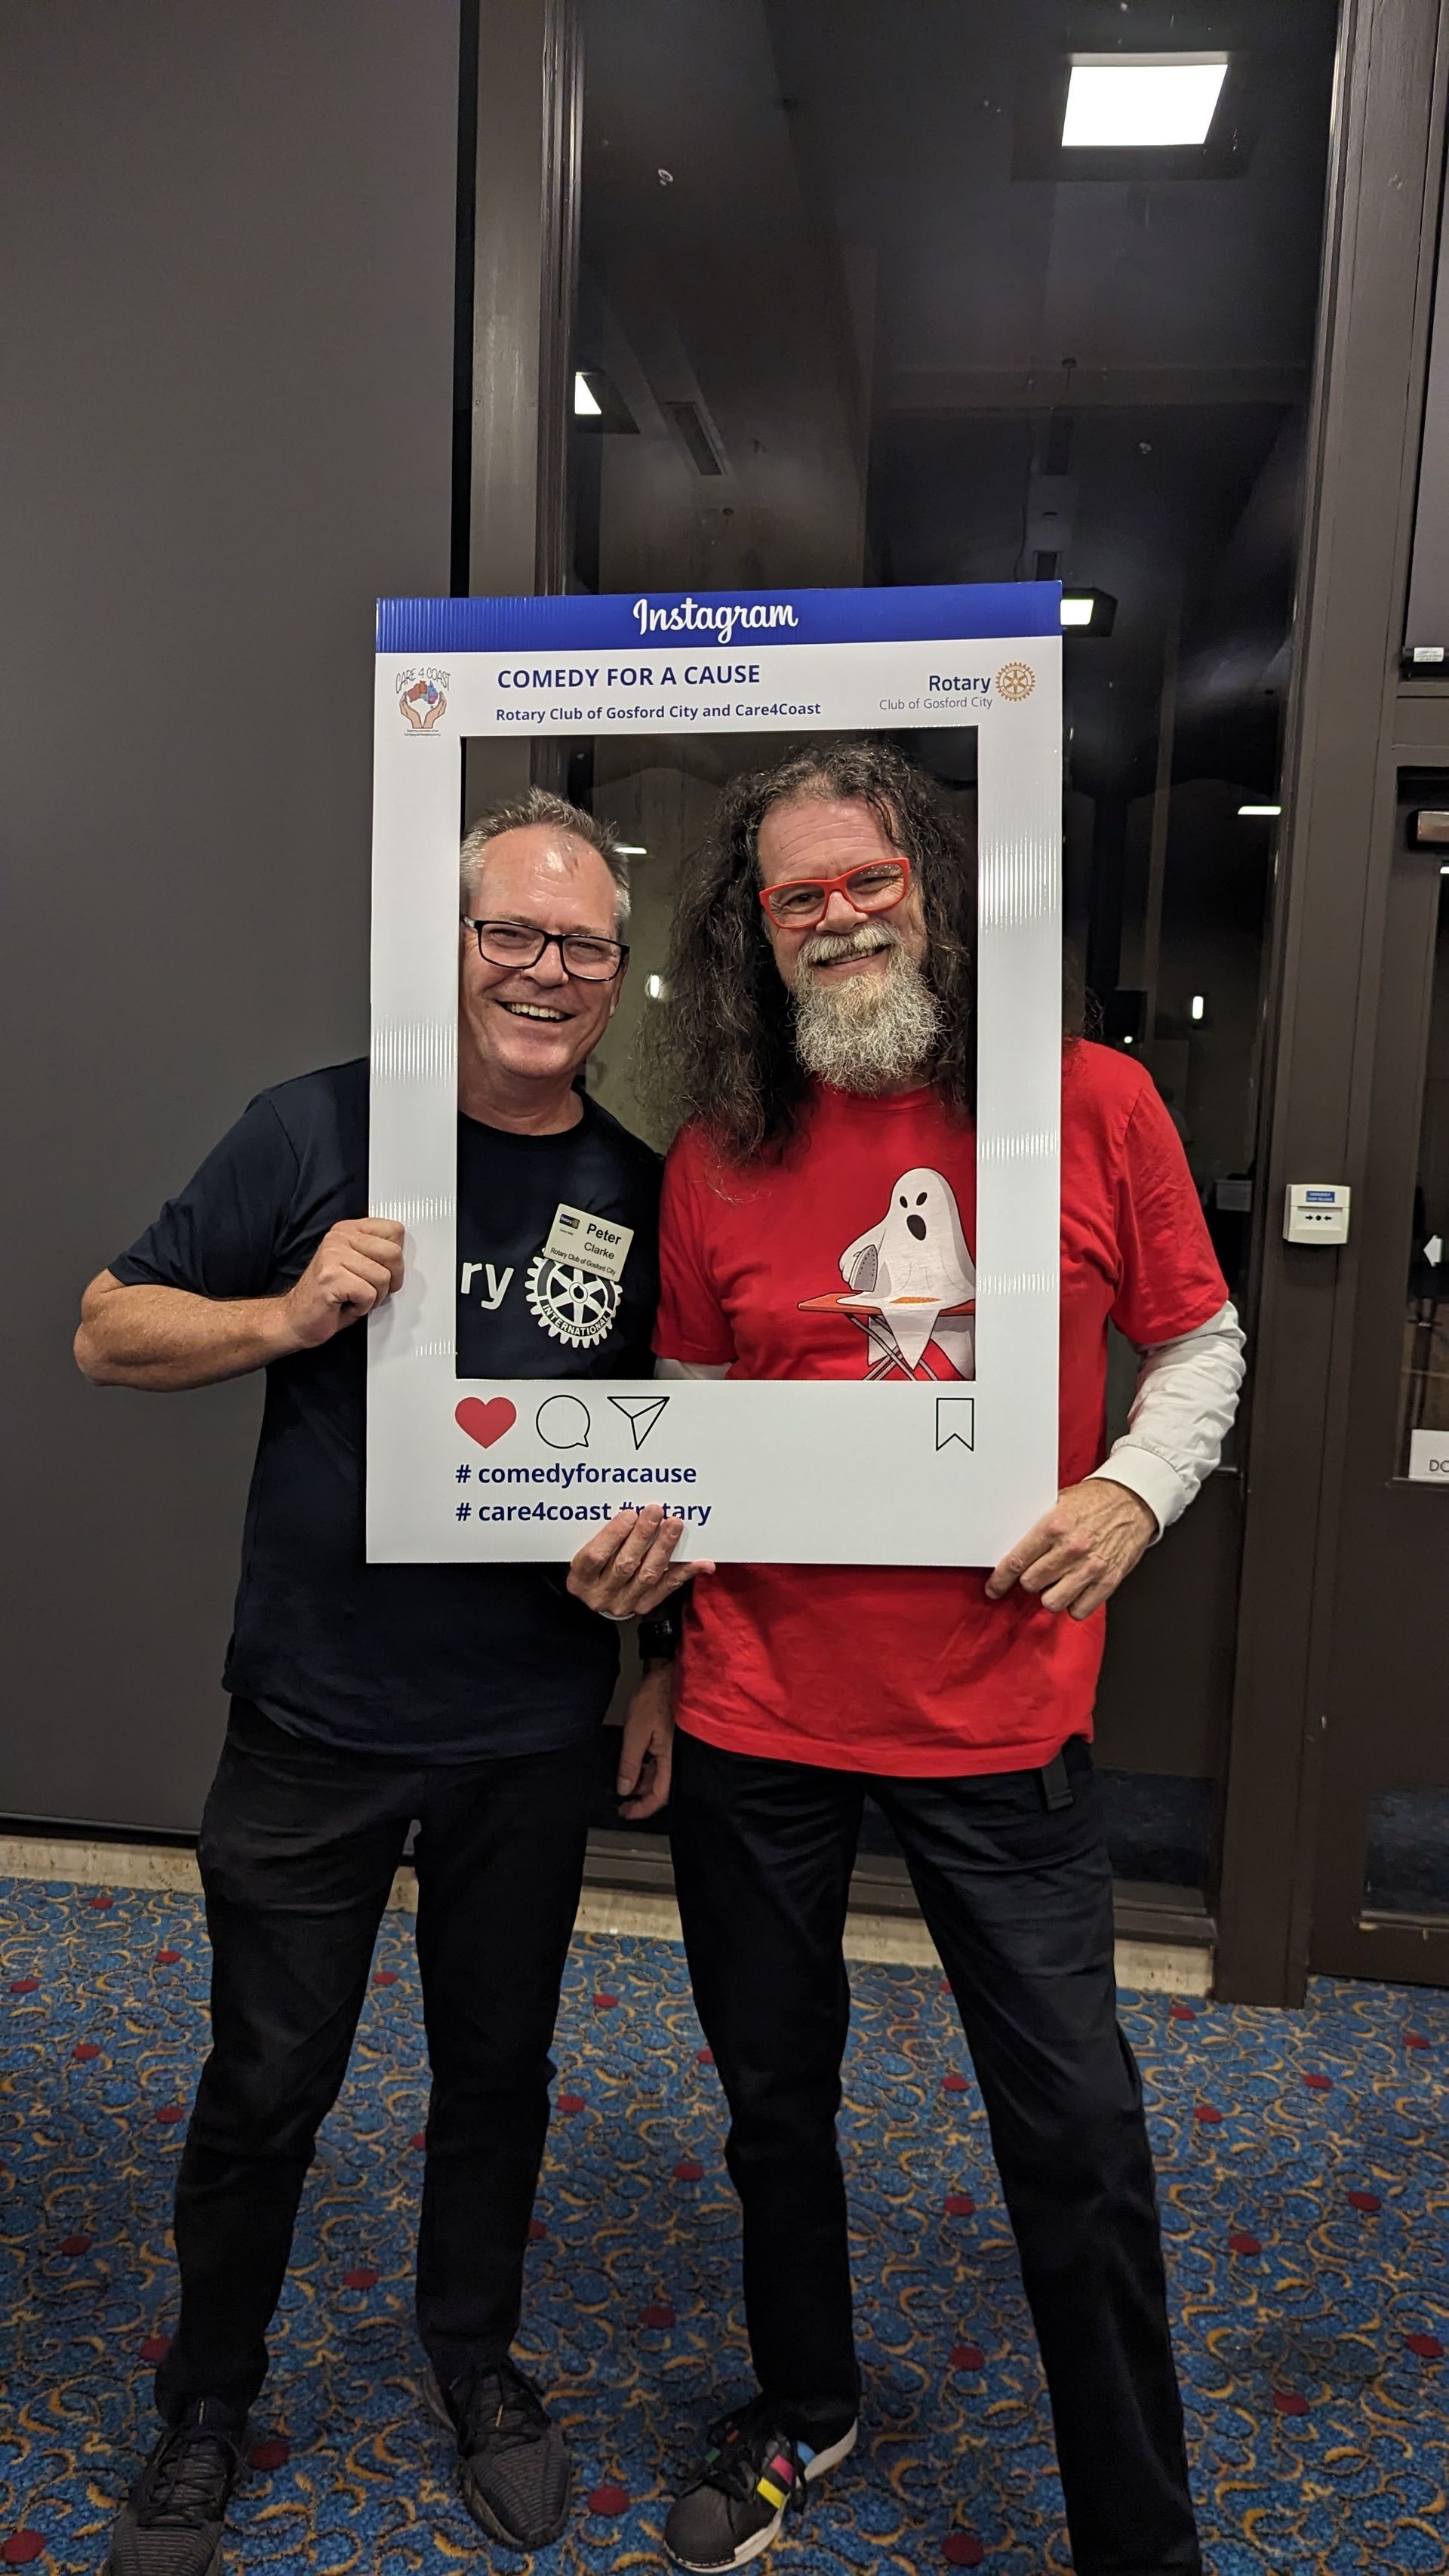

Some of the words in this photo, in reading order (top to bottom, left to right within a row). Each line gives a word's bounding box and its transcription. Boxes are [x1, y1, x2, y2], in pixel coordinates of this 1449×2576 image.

[632, 597, 798, 644] Instagram
[395, 668, 417, 694] CARE
[418, 667, 425, 678] 4
[426, 667, 451, 691] COAST
[497, 669, 600, 688] COMEDY
[607, 667, 654, 686] FOR
[660, 666, 677, 685] A
[684, 664, 760, 685] CAUSE
[929, 675, 991, 693] Rotary
[496, 709, 546, 724] Rotary
[550, 707, 583, 720] Club
[587, 707, 603, 719] of
[606, 705, 665, 719] Gosford
[669, 704, 698, 720] City
[703, 703, 731, 717] and
[735, 703, 821, 716] Care4Coast
[879, 699, 905, 710] Club
[908, 698, 920, 709] of
[923, 697, 968, 709] Gosford
[971, 697, 992, 709] City
[586, 1223, 623, 1245] Peter
[550, 1247, 568, 1259] Rotary
[568, 1253, 580, 1263] Club
[586, 1260, 606, 1272] Gosford
[606, 1266, 617, 1276] City
[584, 1242, 614, 1260] Clarke
[460, 1262, 515, 1310] ry
[542, 1303, 611, 1337] INTERNATIONAL
[456, 1464, 471, 1483] #
[478, 1463, 697, 1488] comedyforacause
[456, 1502, 472, 1521] #
[478, 1502, 612, 1521] care4coast
[619, 1501, 712, 1526] rtary
